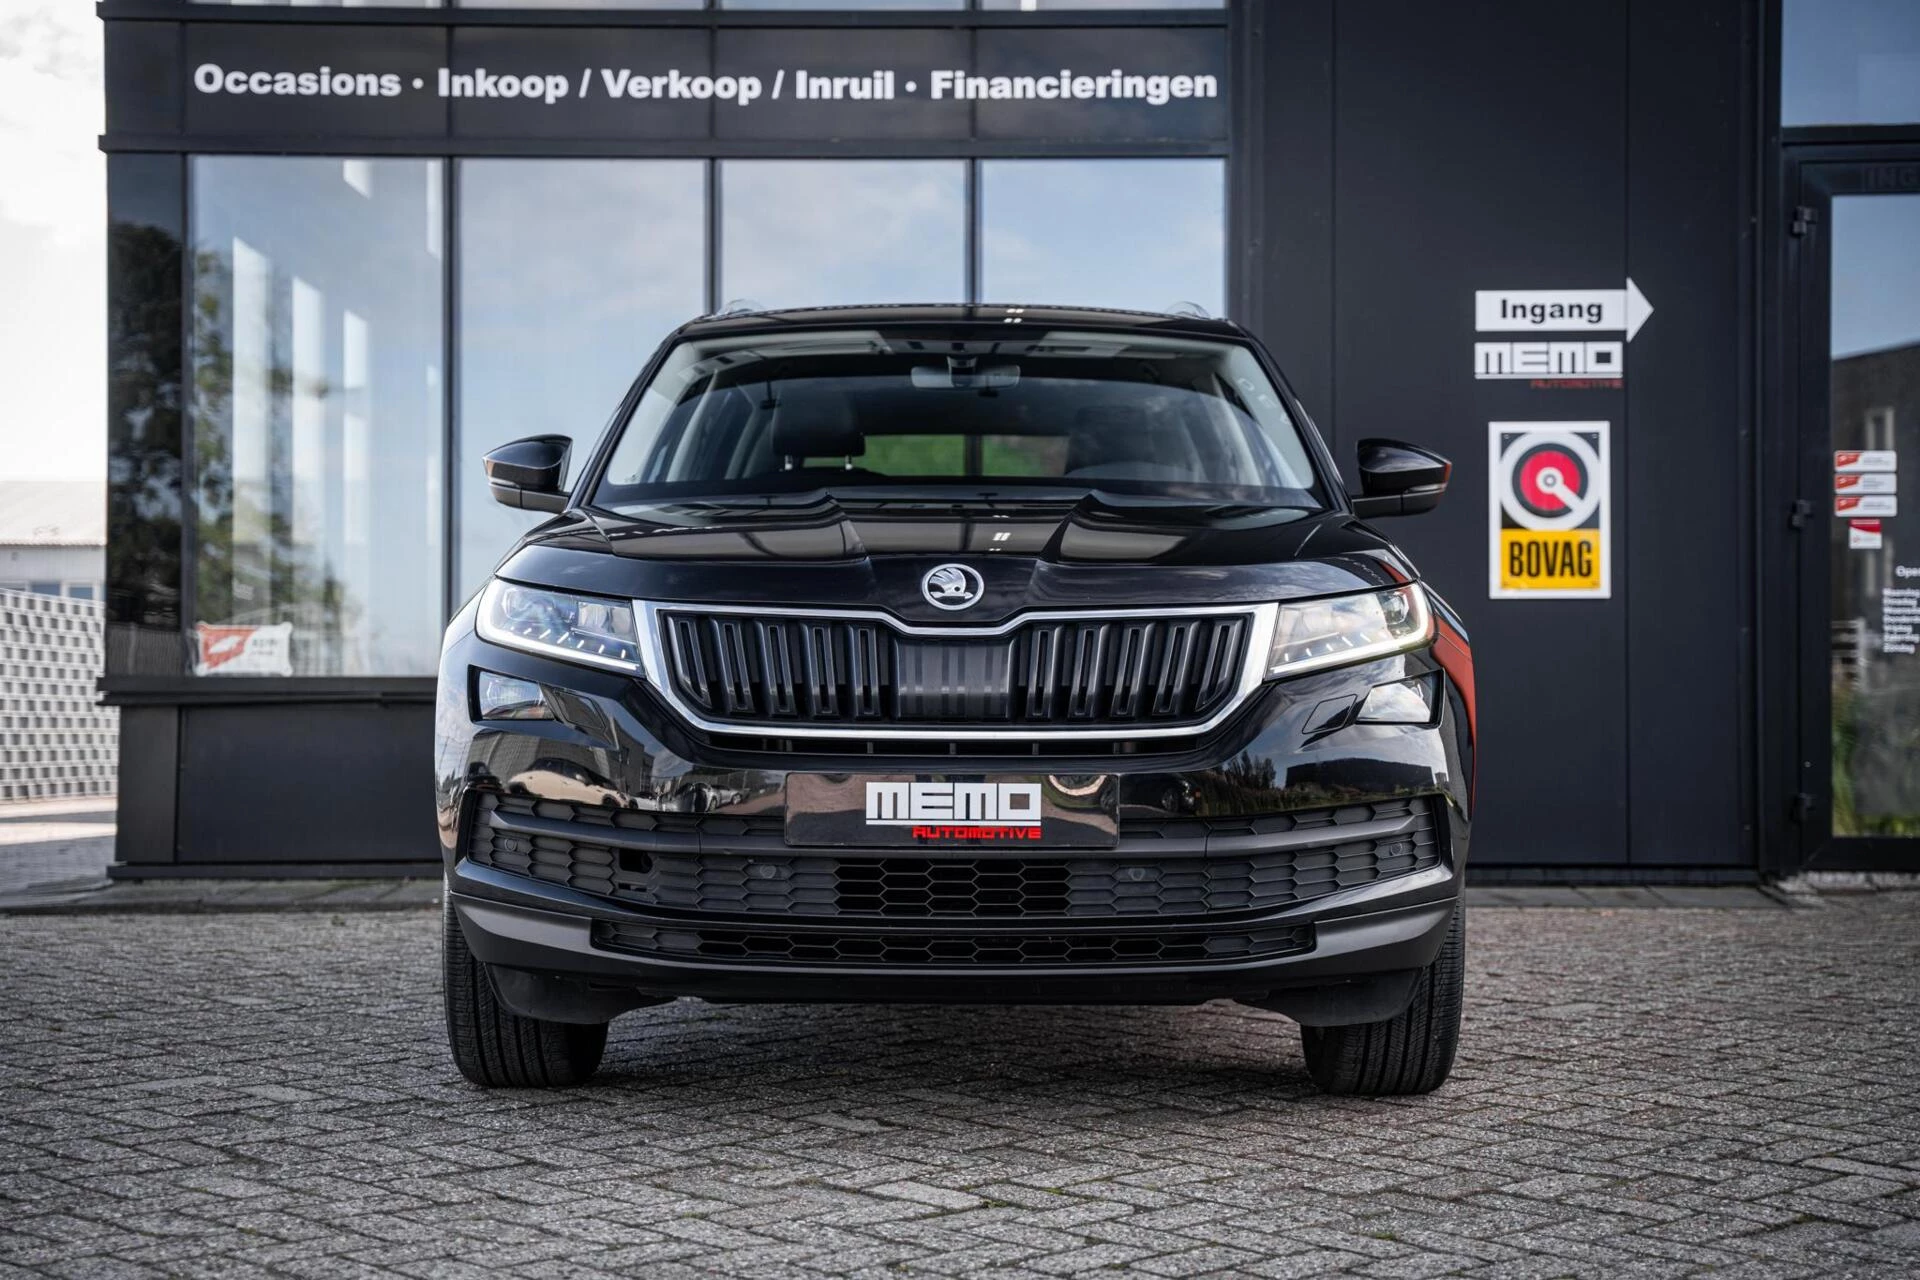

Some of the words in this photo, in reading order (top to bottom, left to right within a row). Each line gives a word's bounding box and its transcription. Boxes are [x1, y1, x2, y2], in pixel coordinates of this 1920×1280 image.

[194, 63, 402, 97] Occasions
[438, 67, 569, 105] Inkoop
[600, 68, 762, 106] Verkoop
[795, 69, 895, 100] Inruil
[930, 68, 1218, 106] Financieringen
[1501, 298, 1603, 325] Ingang
[1474, 341, 1623, 374] MEMO
[1508, 540, 1593, 578] BOVAG
[866, 782, 1041, 820] MEMO
[912, 826, 1041, 840] AUTOMOTIVE
